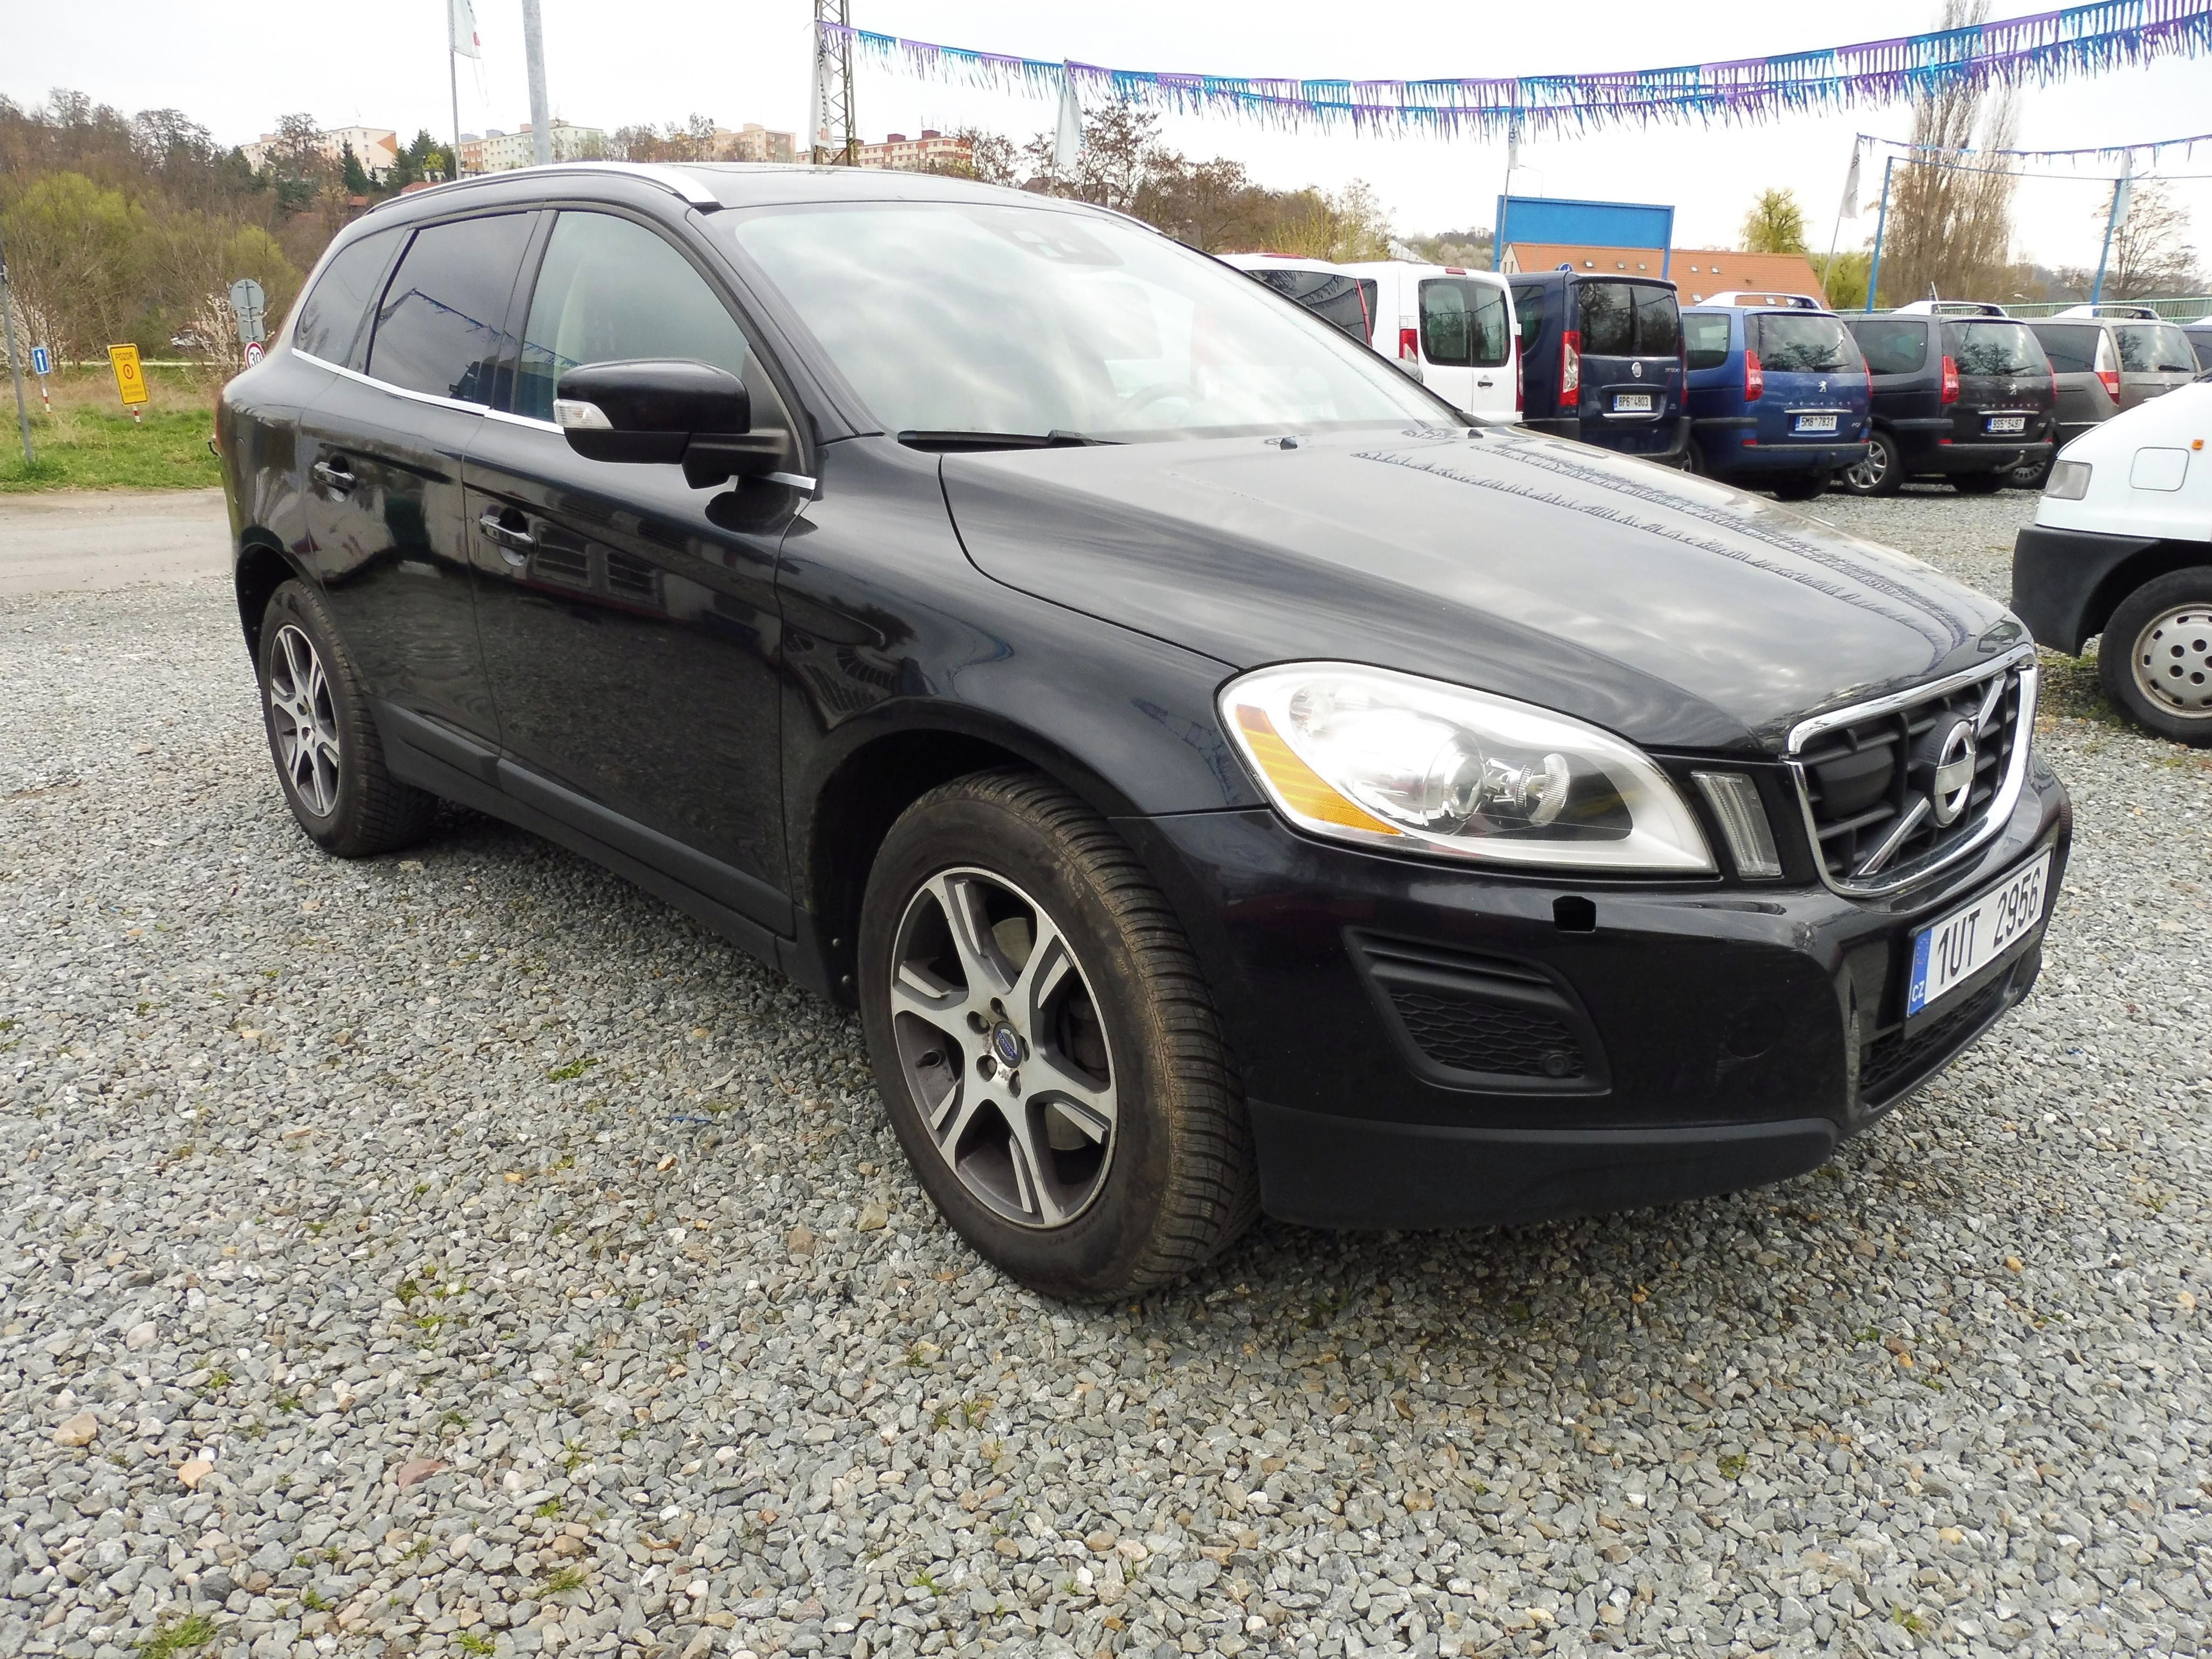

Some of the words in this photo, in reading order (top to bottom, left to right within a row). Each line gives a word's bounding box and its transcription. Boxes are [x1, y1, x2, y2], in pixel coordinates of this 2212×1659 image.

[250, 352, 262, 367] 30
[1618, 397, 1630, 407] 8P6
[1634, 397, 1648, 407] 4803
[1801, 417, 1813, 427] 5M8
[1817, 417, 1833, 427] 7831
[1937, 908, 1981, 986] 1UT
[1993, 866, 2040, 948] 2956
[1911, 980, 1925, 1002] CZ
